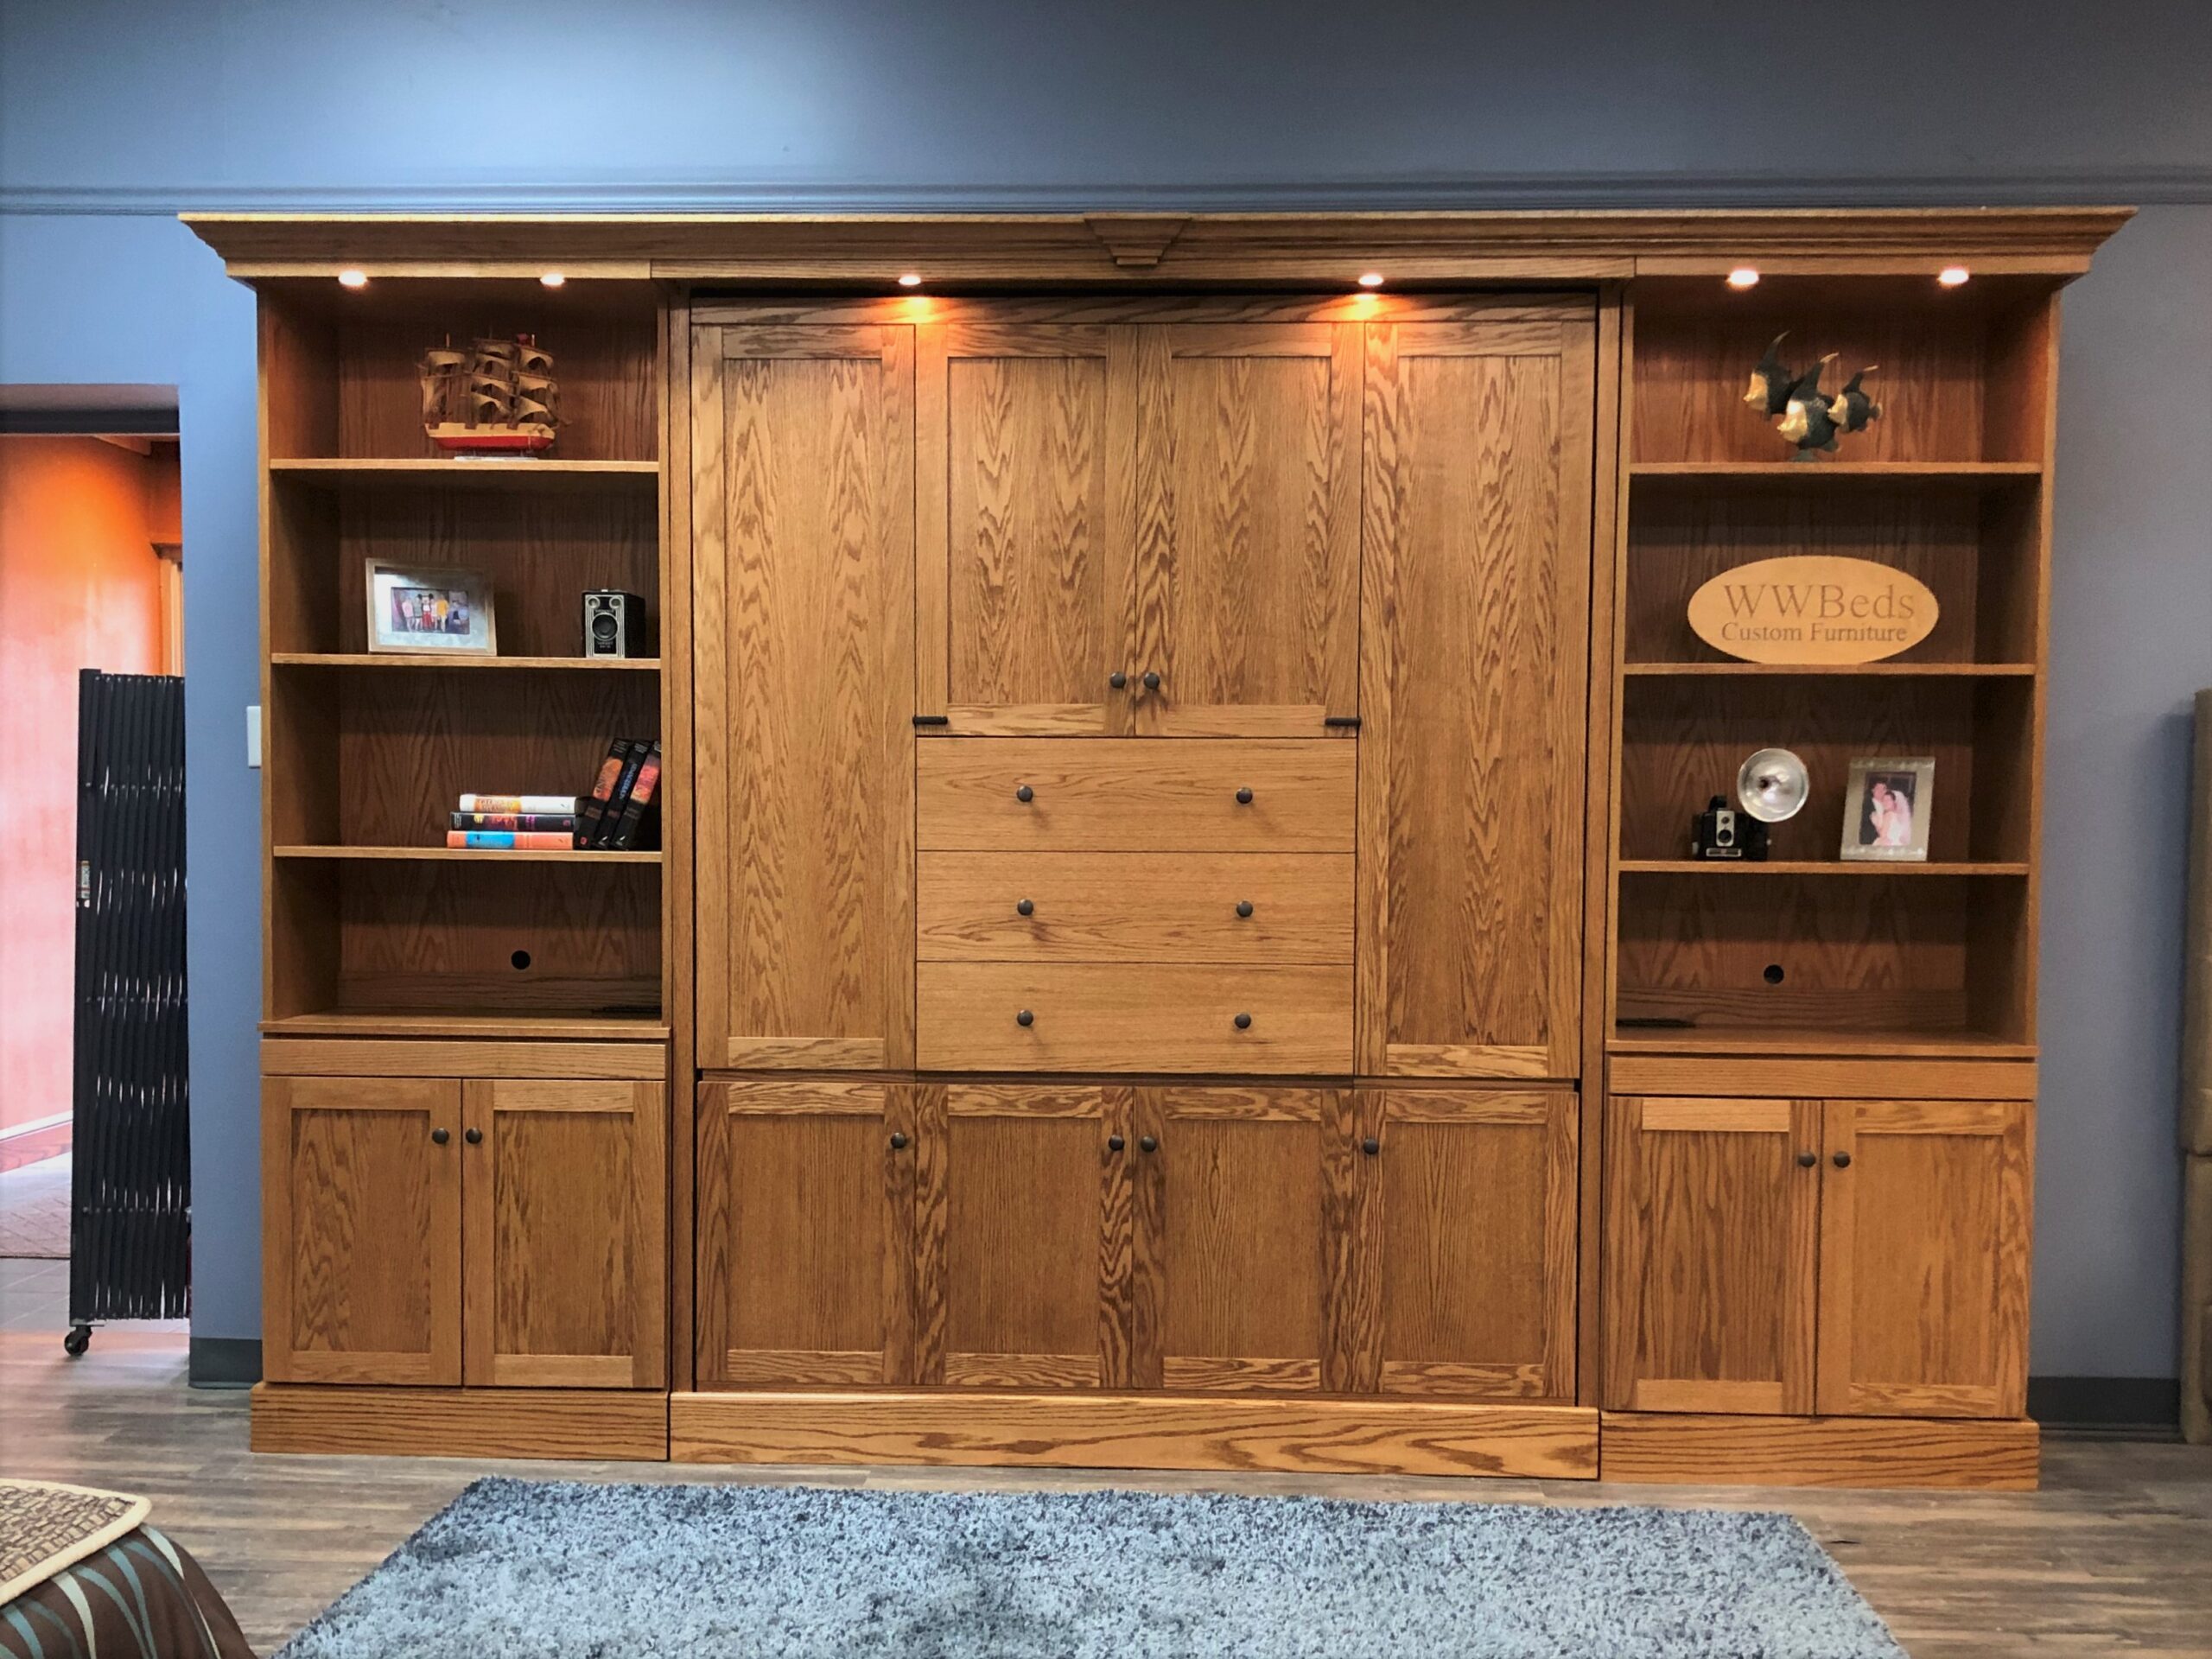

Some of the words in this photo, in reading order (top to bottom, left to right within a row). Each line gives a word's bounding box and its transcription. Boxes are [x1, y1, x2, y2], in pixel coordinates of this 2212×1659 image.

[1724, 584, 1915, 620] WWBeds
[1721, 622, 1802, 641] Custom
[1810, 622, 1908, 641] Furniture
